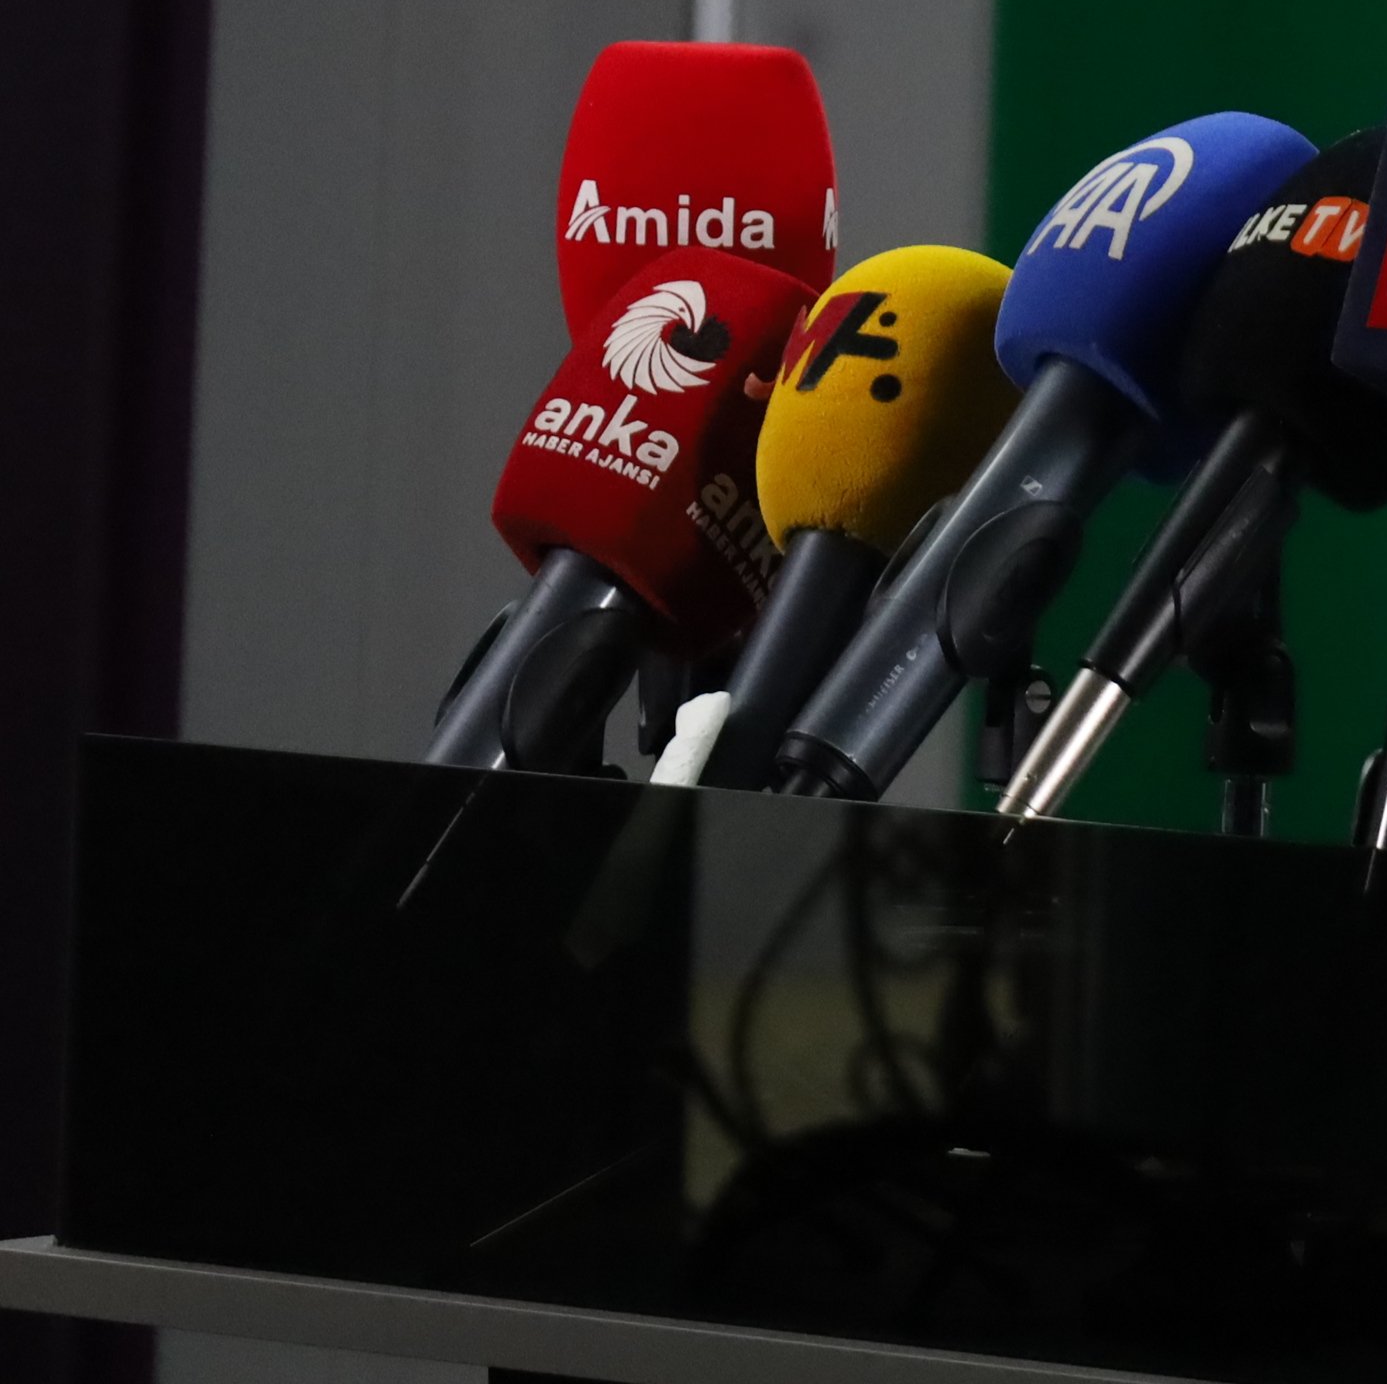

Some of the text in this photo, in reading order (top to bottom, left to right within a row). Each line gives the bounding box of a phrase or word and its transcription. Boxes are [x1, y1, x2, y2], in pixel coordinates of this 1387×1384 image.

[565, 179, 775, 249] Amida
[1027, 162, 1159, 261] AA
[1303, 205, 1367, 253] TV
[522, 432, 661, 490] HABER AJANSI
[534, 394, 680, 472] anka
[701, 473, 783, 593] ank
